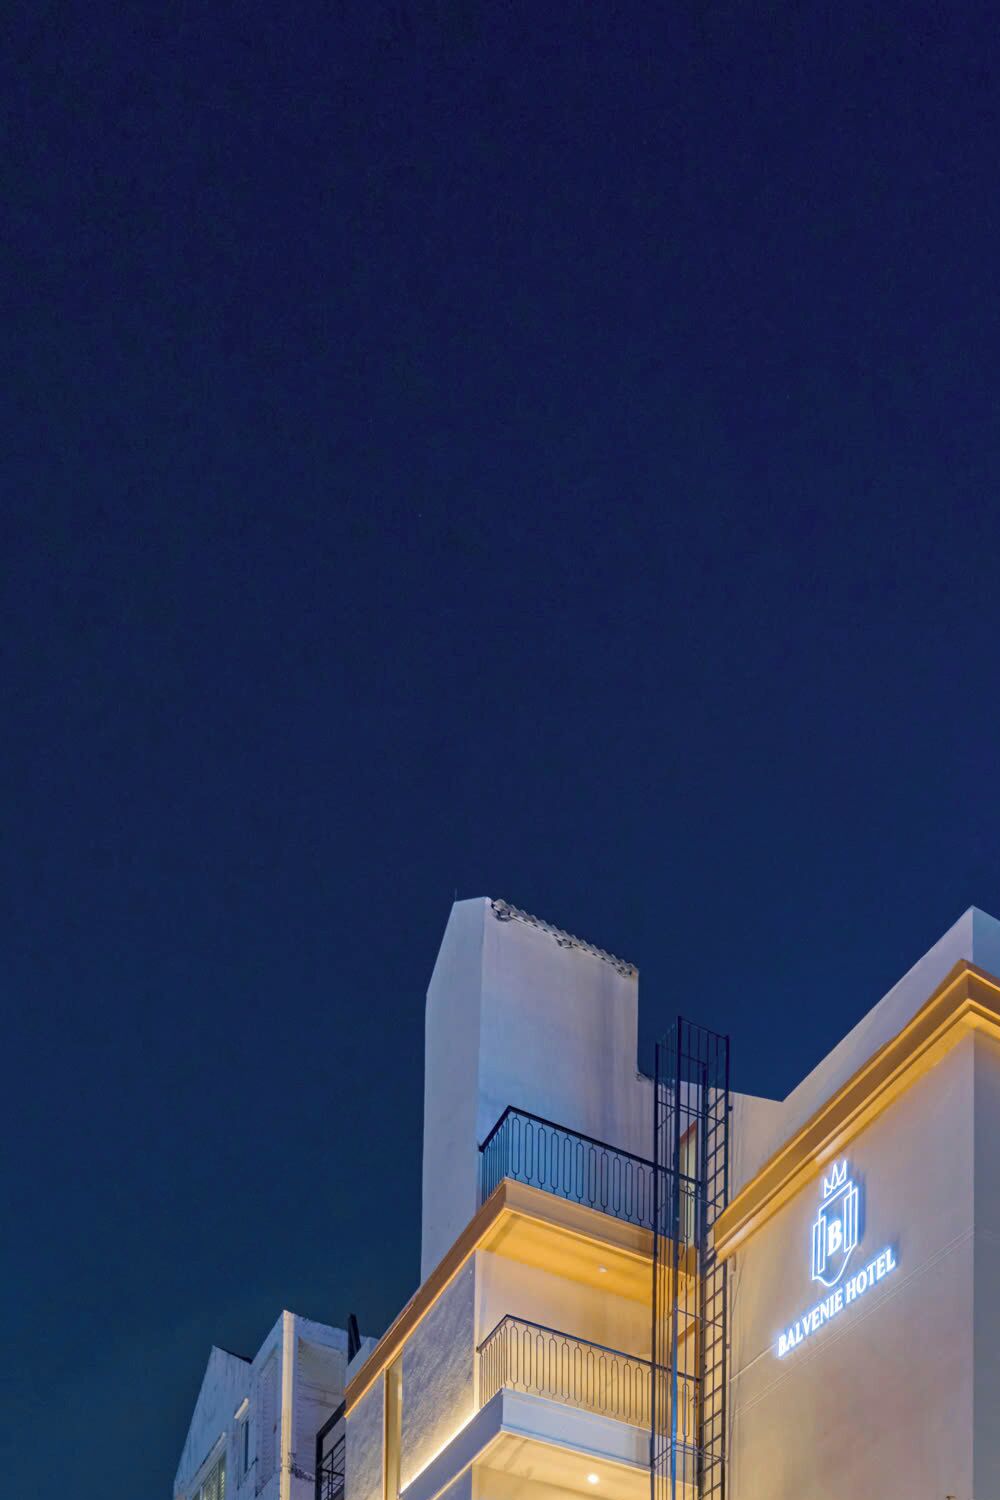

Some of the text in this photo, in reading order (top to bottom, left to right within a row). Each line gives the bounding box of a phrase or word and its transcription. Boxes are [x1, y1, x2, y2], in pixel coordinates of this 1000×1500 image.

[827, 1219, 843, 1256] B
[777, 1248, 896, 1357] BALVENIE HOTEL
